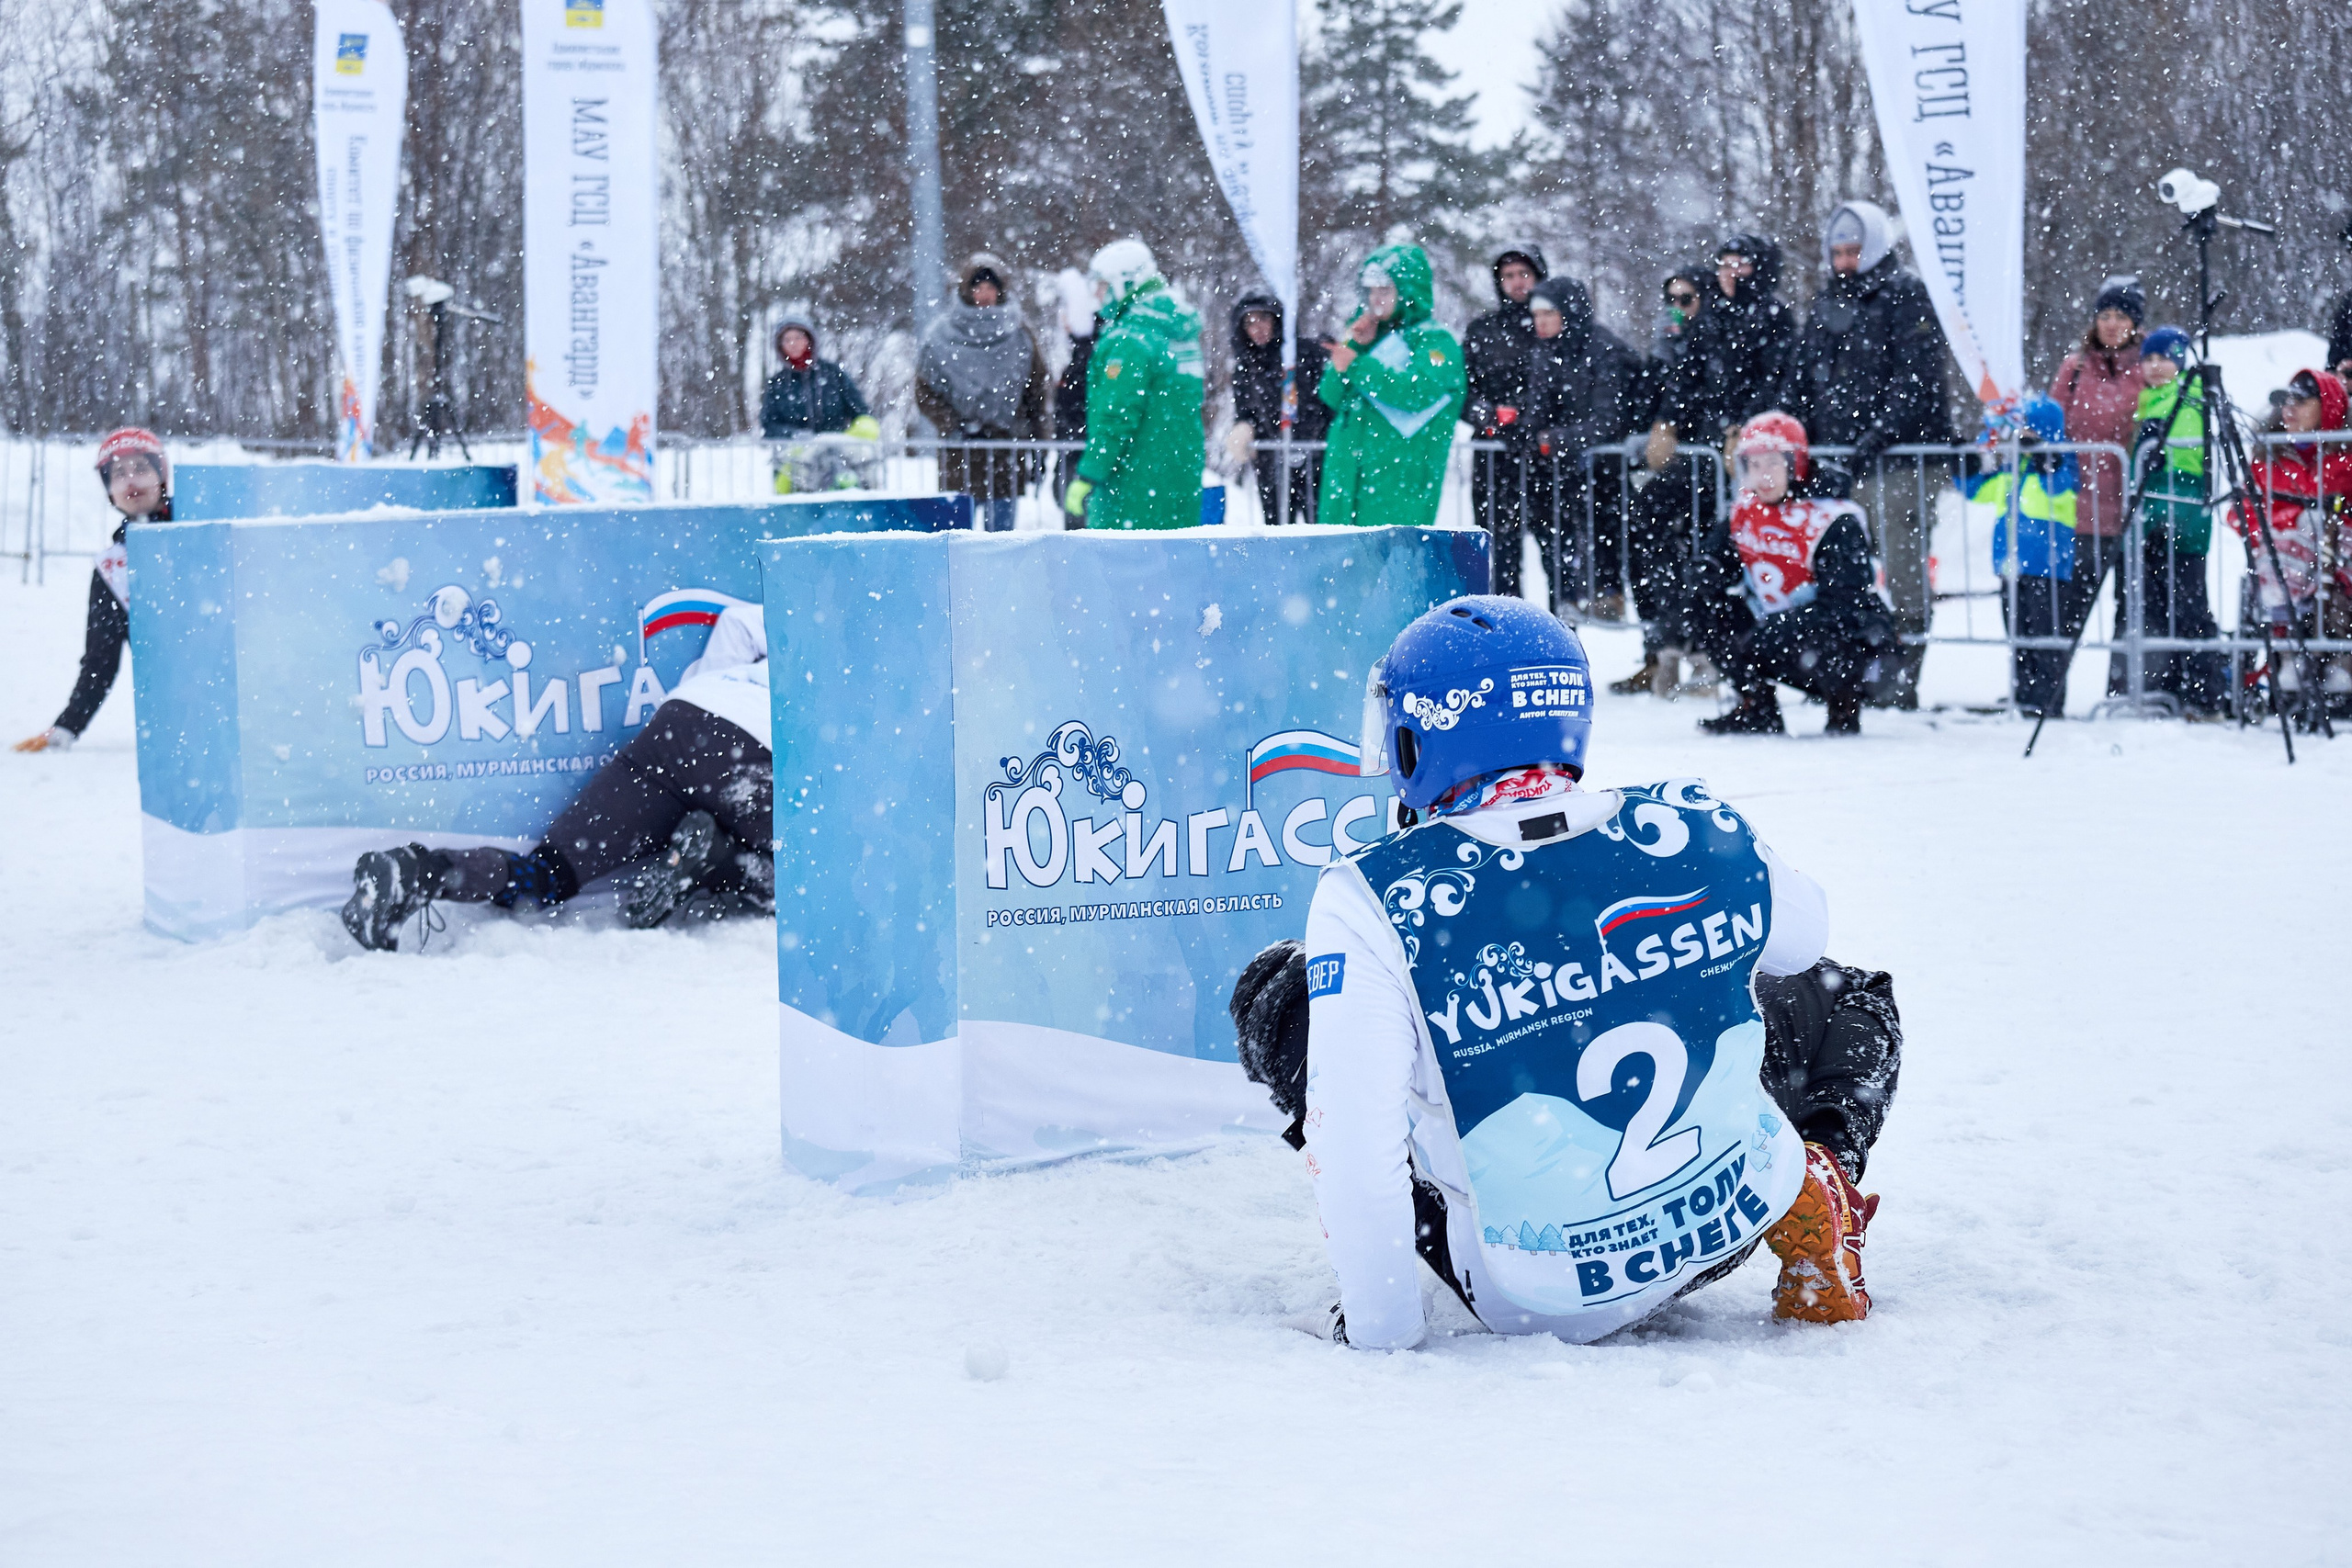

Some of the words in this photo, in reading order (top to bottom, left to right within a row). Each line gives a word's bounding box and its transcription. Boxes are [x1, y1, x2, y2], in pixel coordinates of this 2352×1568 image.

[1911, 41, 1970, 122] ГСЦ
[571, 97, 609, 160] МАУ
[568, 175, 609, 225] ГСЦ
[564, 241, 609, 400] «Авангард»
[358, 632, 669, 748] ЮКИГА
[1510, 673, 1528, 682] ДЛЯ
[1512, 691, 1528, 707] В
[1531, 689, 1586, 706] СНЕГЕ
[1549, 671, 1584, 687] ТОЛК
[1520, 710, 1546, 719] АНТОН
[366, 763, 454, 784] РОССИЯ,
[457, 754, 595, 779] МУРМАНСКАЯ
[984, 767, 1400, 889] ЮКИГАСС
[987, 907, 1068, 927] РОССИЯ,
[1069, 898, 1199, 922] МУРМАНСКАЯ
[1203, 893, 1283, 913] ОБЛАСТЬ
[1307, 960, 1340, 995] ЕВЕР
[1453, 1041, 1495, 1058] RUSSIA,
[1496, 1019, 1549, 1046] MURMANSK
[1551, 1007, 1594, 1026] REGION
[1576, 1021, 1702, 1201] 2
[1569, 1227, 1611, 1248] ДЛЯ
[1613, 1213, 1655, 1236] ТЕХ,
[1571, 1246, 1605, 1258] КТО
[1608, 1227, 1658, 1252] ЗНАЕТ
[1576, 1259, 1614, 1297] В
[1624, 1183, 1770, 1283] СНЕГЕ
